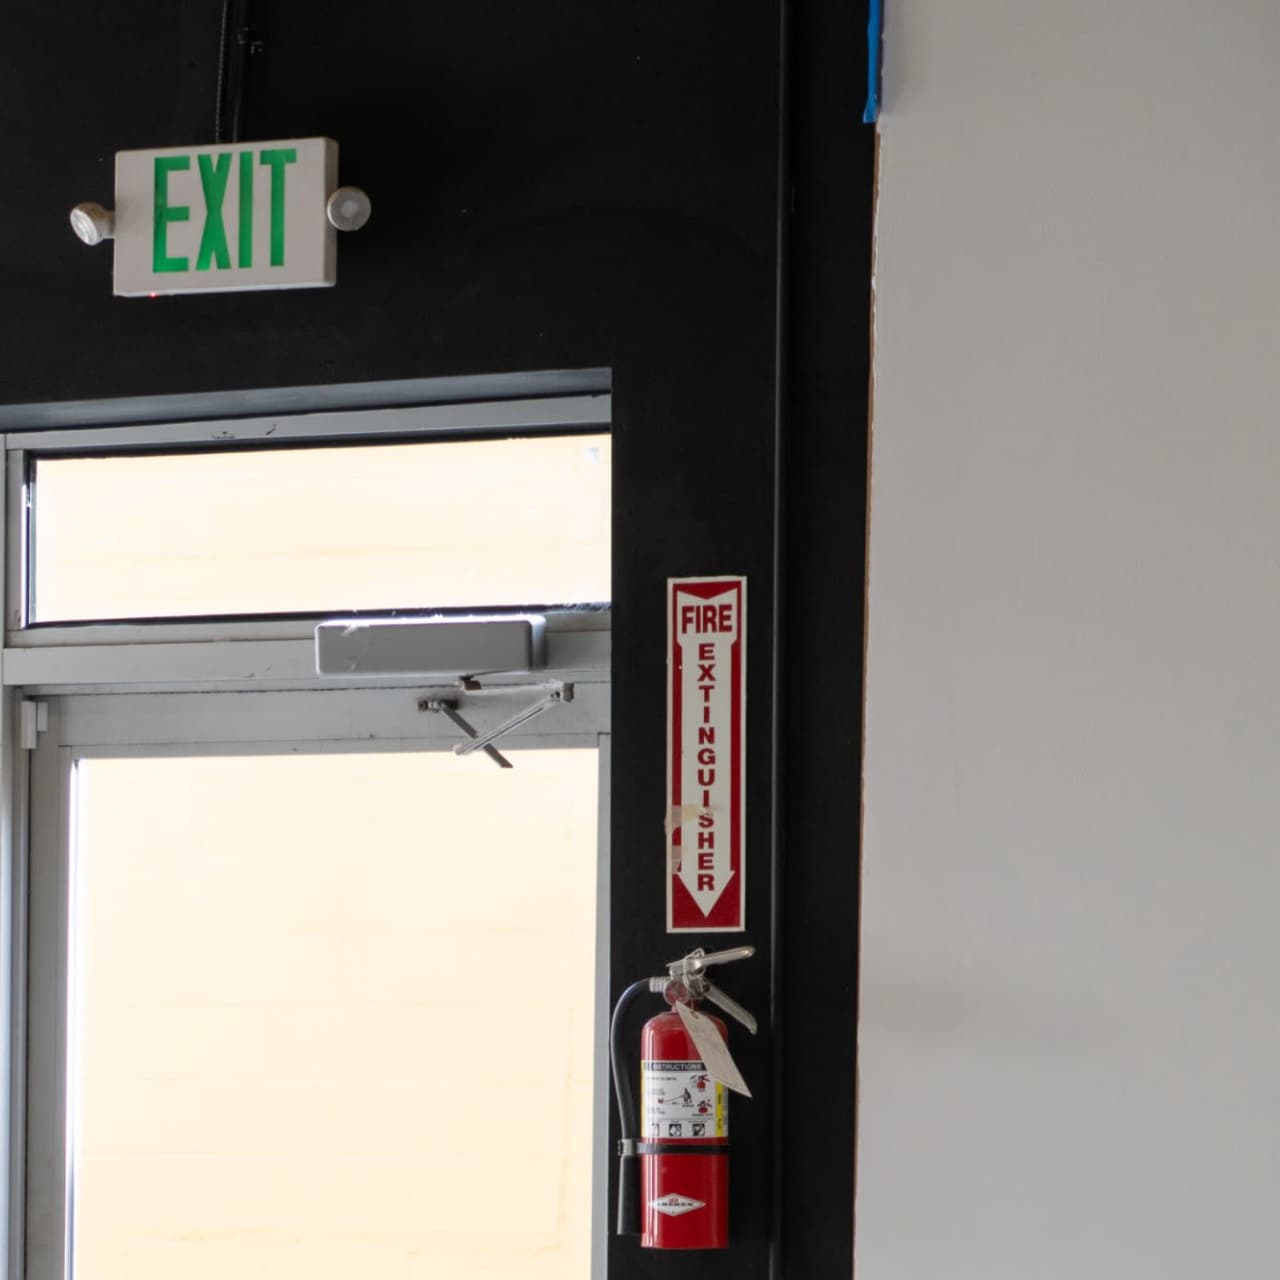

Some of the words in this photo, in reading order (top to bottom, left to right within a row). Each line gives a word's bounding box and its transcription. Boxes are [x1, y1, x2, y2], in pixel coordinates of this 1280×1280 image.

[153, 148, 297, 274] EXIT
[681, 604, 733, 635] FIRE
[697, 643, 716, 891] EXTINGUISHER
